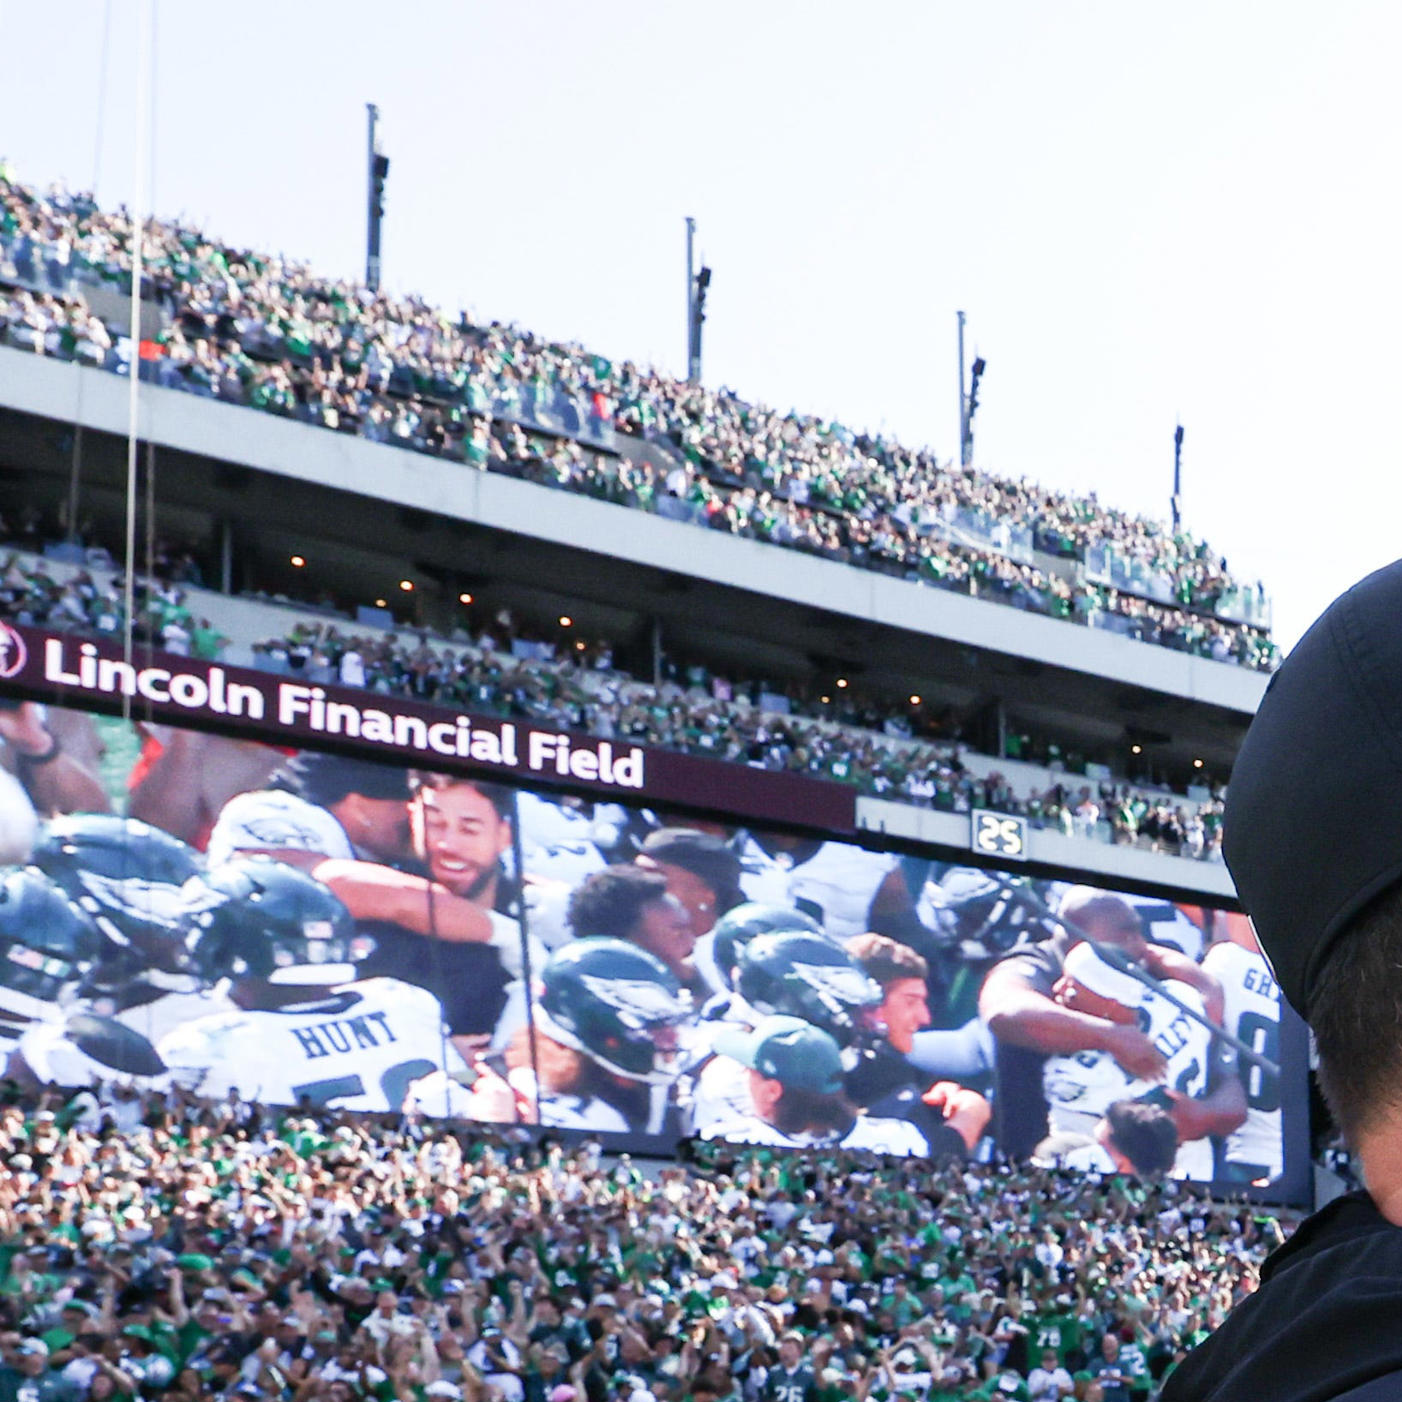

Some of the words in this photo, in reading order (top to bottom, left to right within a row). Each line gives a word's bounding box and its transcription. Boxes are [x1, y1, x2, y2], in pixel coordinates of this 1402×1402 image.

[45, 638, 264, 719] Lincoln
[279, 683, 518, 767] Financial
[528, 731, 644, 788] Field
[978, 816, 1022, 855] 25
[290, 1011, 397, 1059] HUNT
